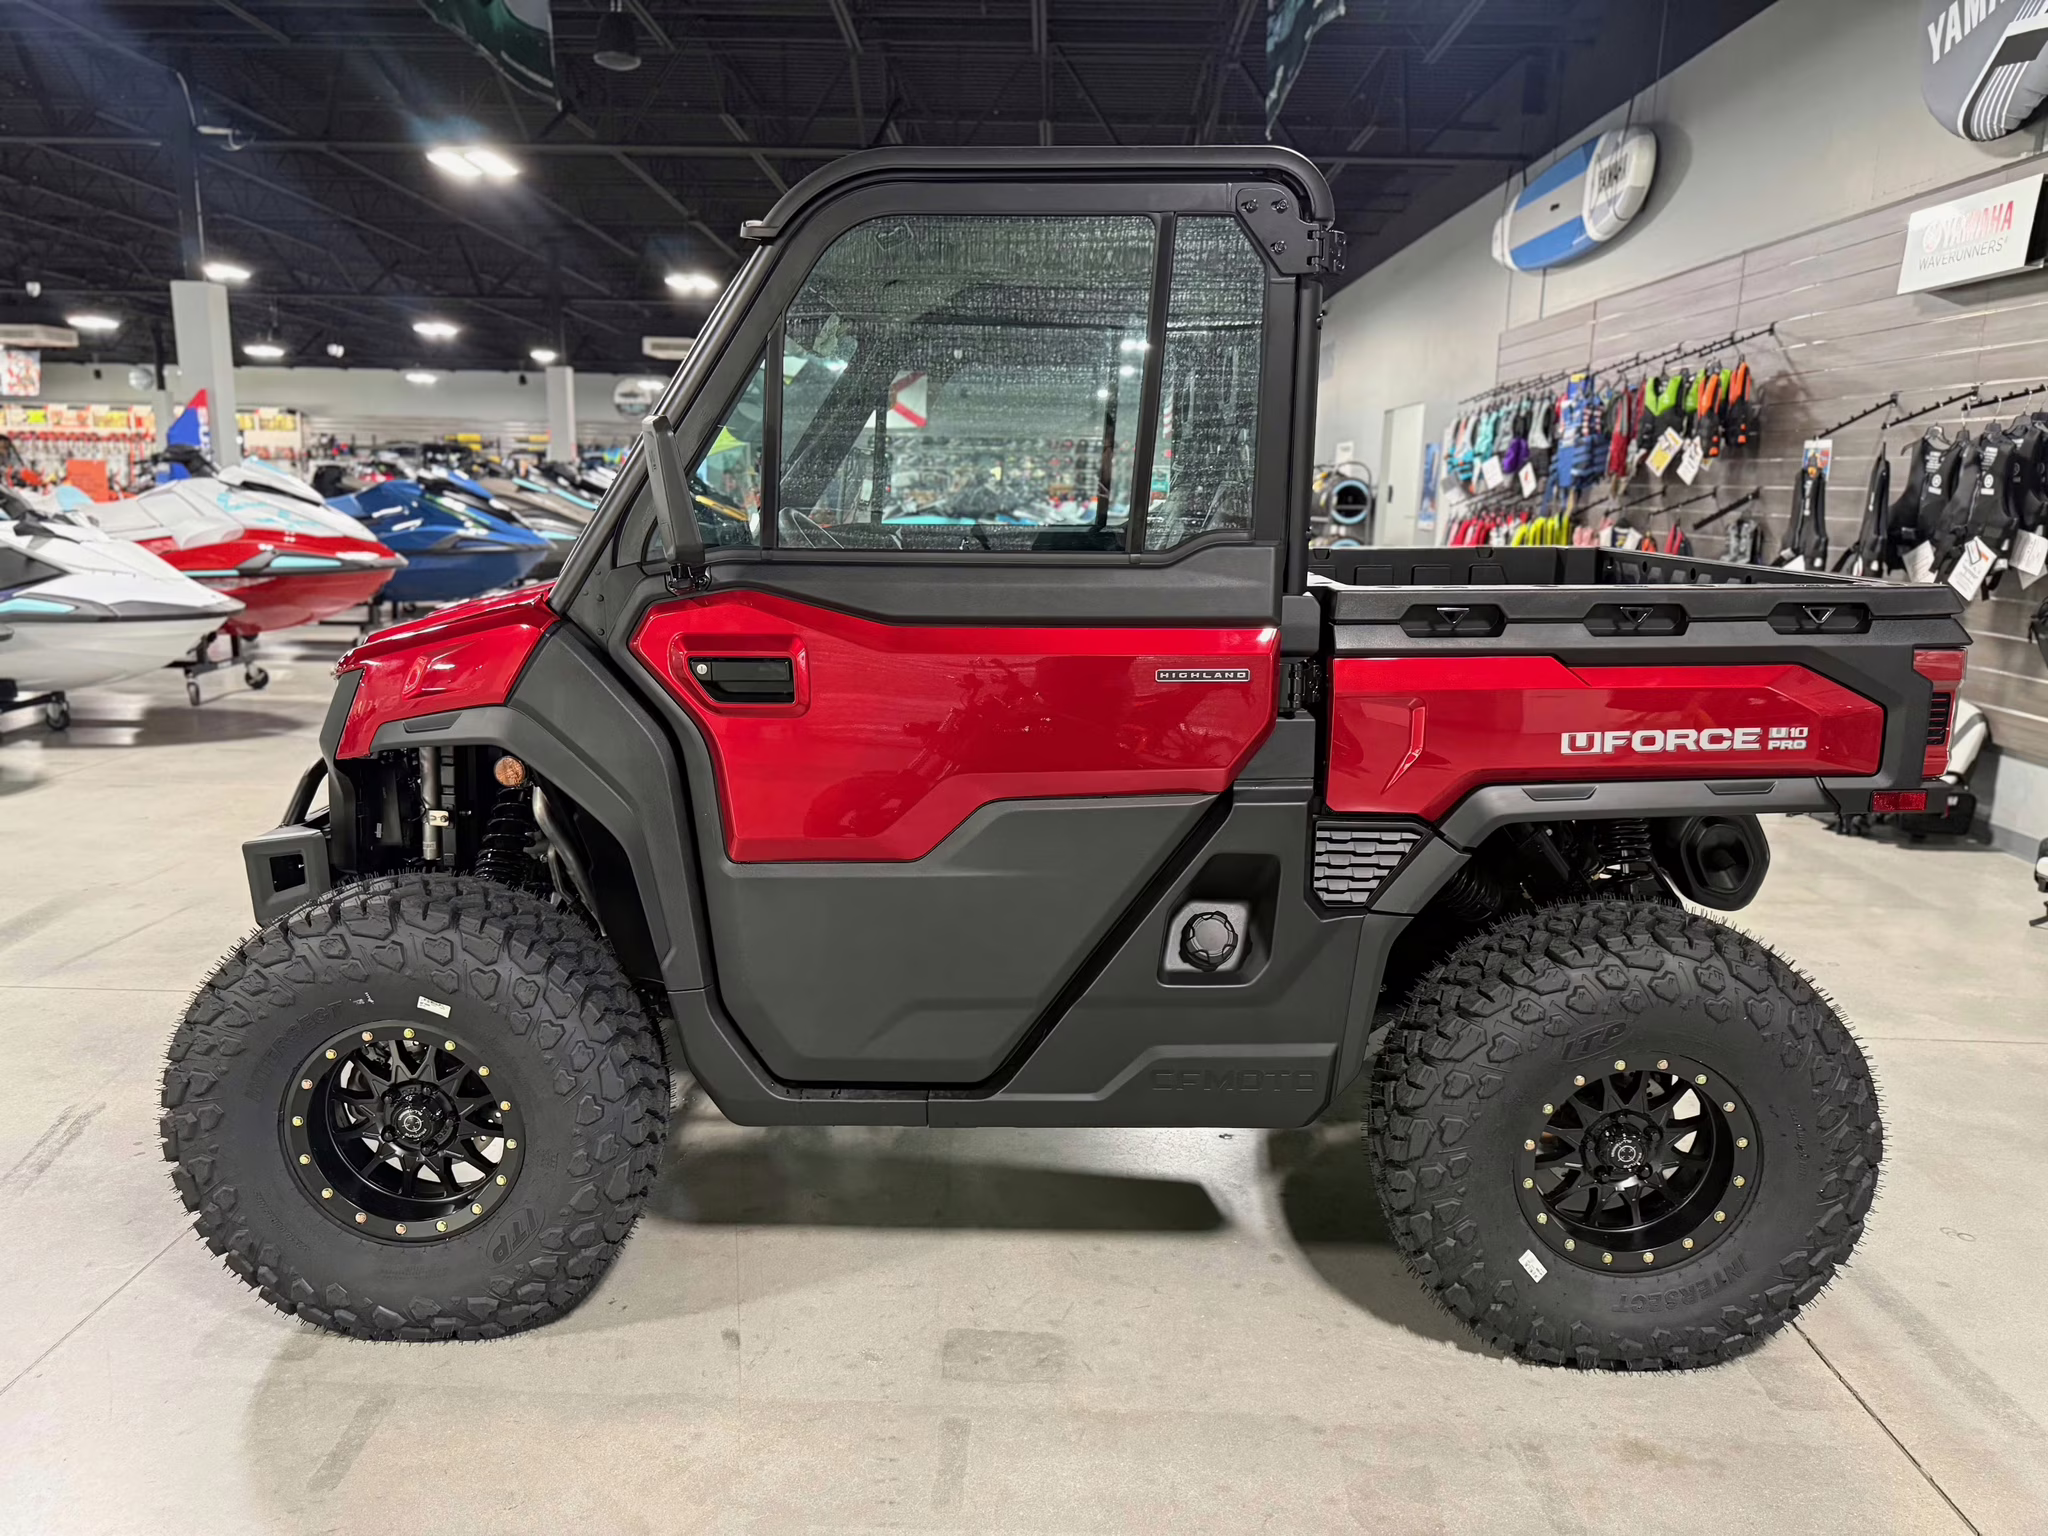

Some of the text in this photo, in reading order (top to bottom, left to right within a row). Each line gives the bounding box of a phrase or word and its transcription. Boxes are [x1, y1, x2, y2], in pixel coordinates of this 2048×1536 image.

[1942, 200, 2014, 250] YAMAHA
[1159, 671, 1247, 679] HIGHLAND
[1561, 727, 1762, 754] UFORCE
[1768, 726, 1809, 738] U10
[1768, 739, 1807, 750] PRO
[1561, 1022, 1627, 1060] ITP
[1151, 1070, 1320, 1092] CFMOTO
[492, 1207, 538, 1265] ITP
[1610, 1252, 1750, 1314] INTERSECT
